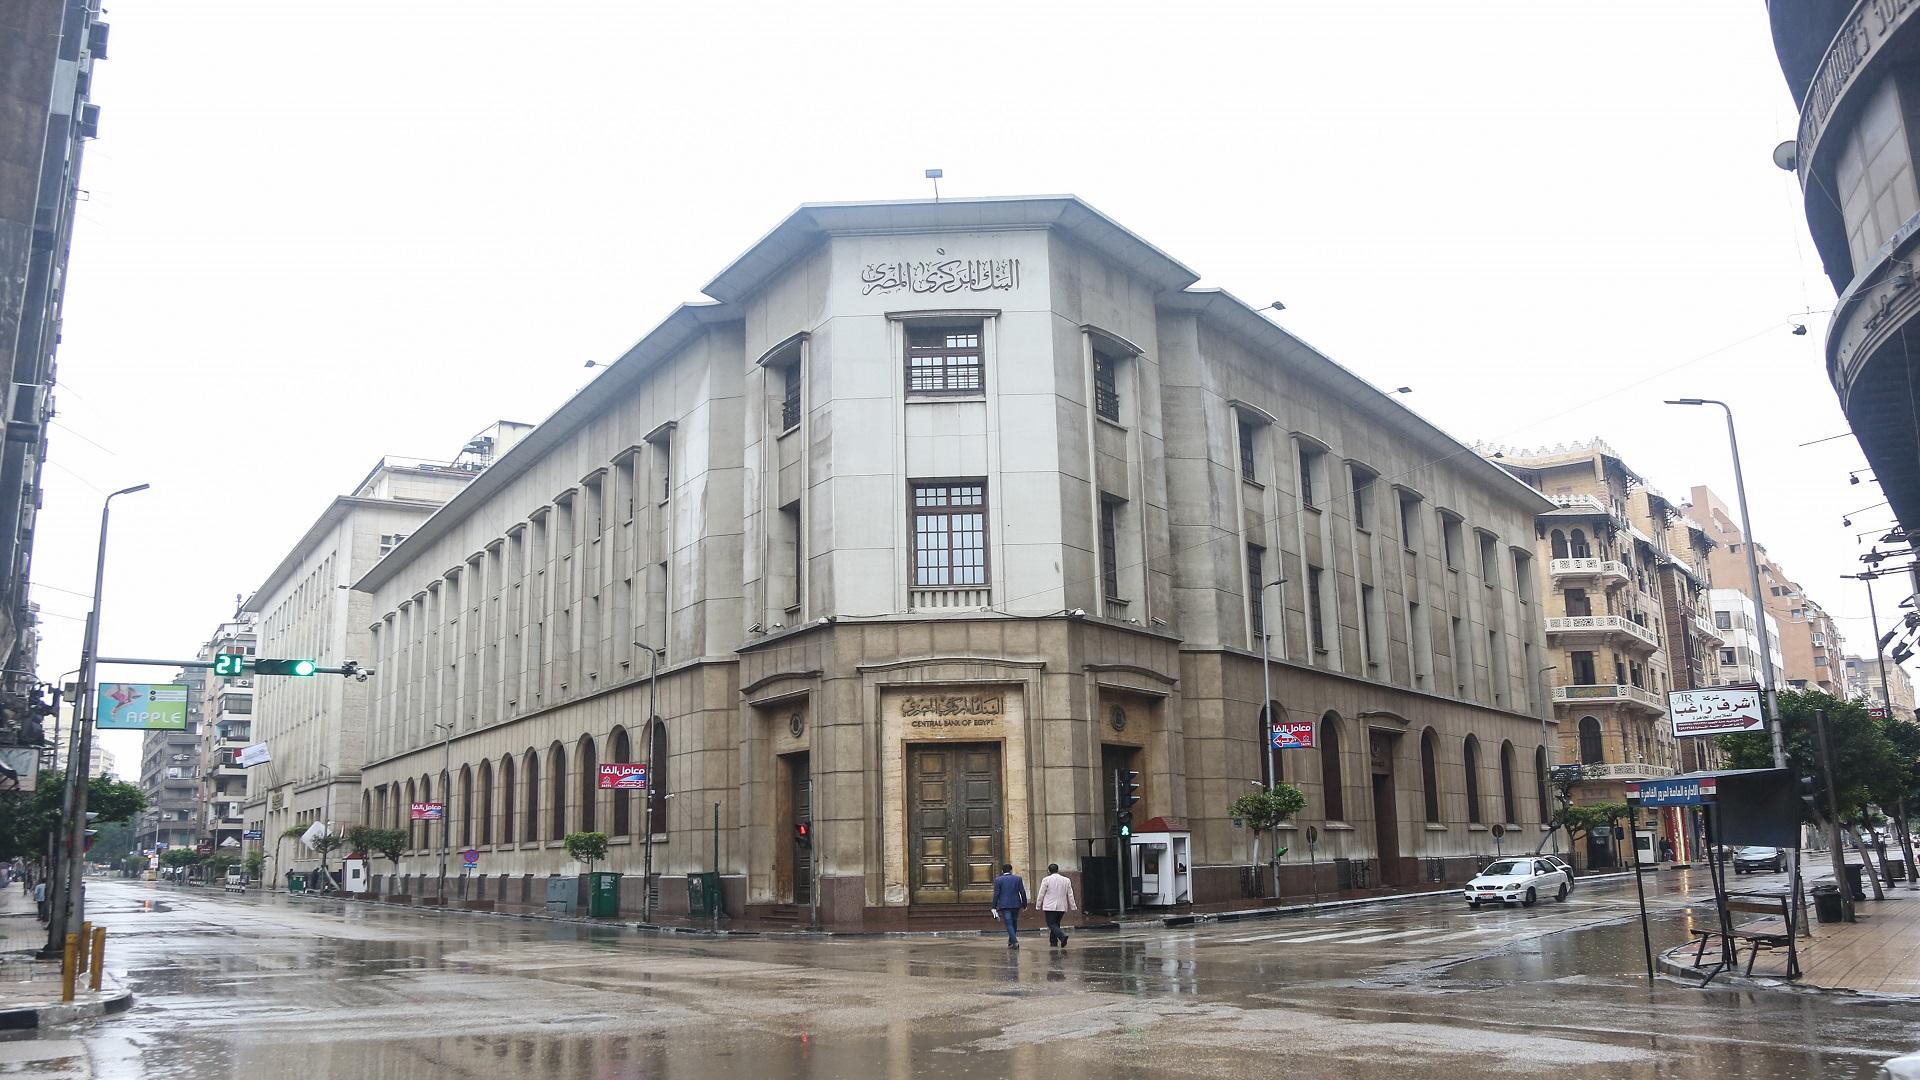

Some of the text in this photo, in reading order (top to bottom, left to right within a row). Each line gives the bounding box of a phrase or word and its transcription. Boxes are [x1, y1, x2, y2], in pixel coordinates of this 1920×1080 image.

[216, 656, 241, 674] 21
[1675, 696, 1756, 716] أشرف راغب
[126, 711, 181, 723] APPLE
[912, 720, 942, 728] CENTRAL
[1287, 724, 1311, 734] معامل
[617, 766, 645, 776] معامل
